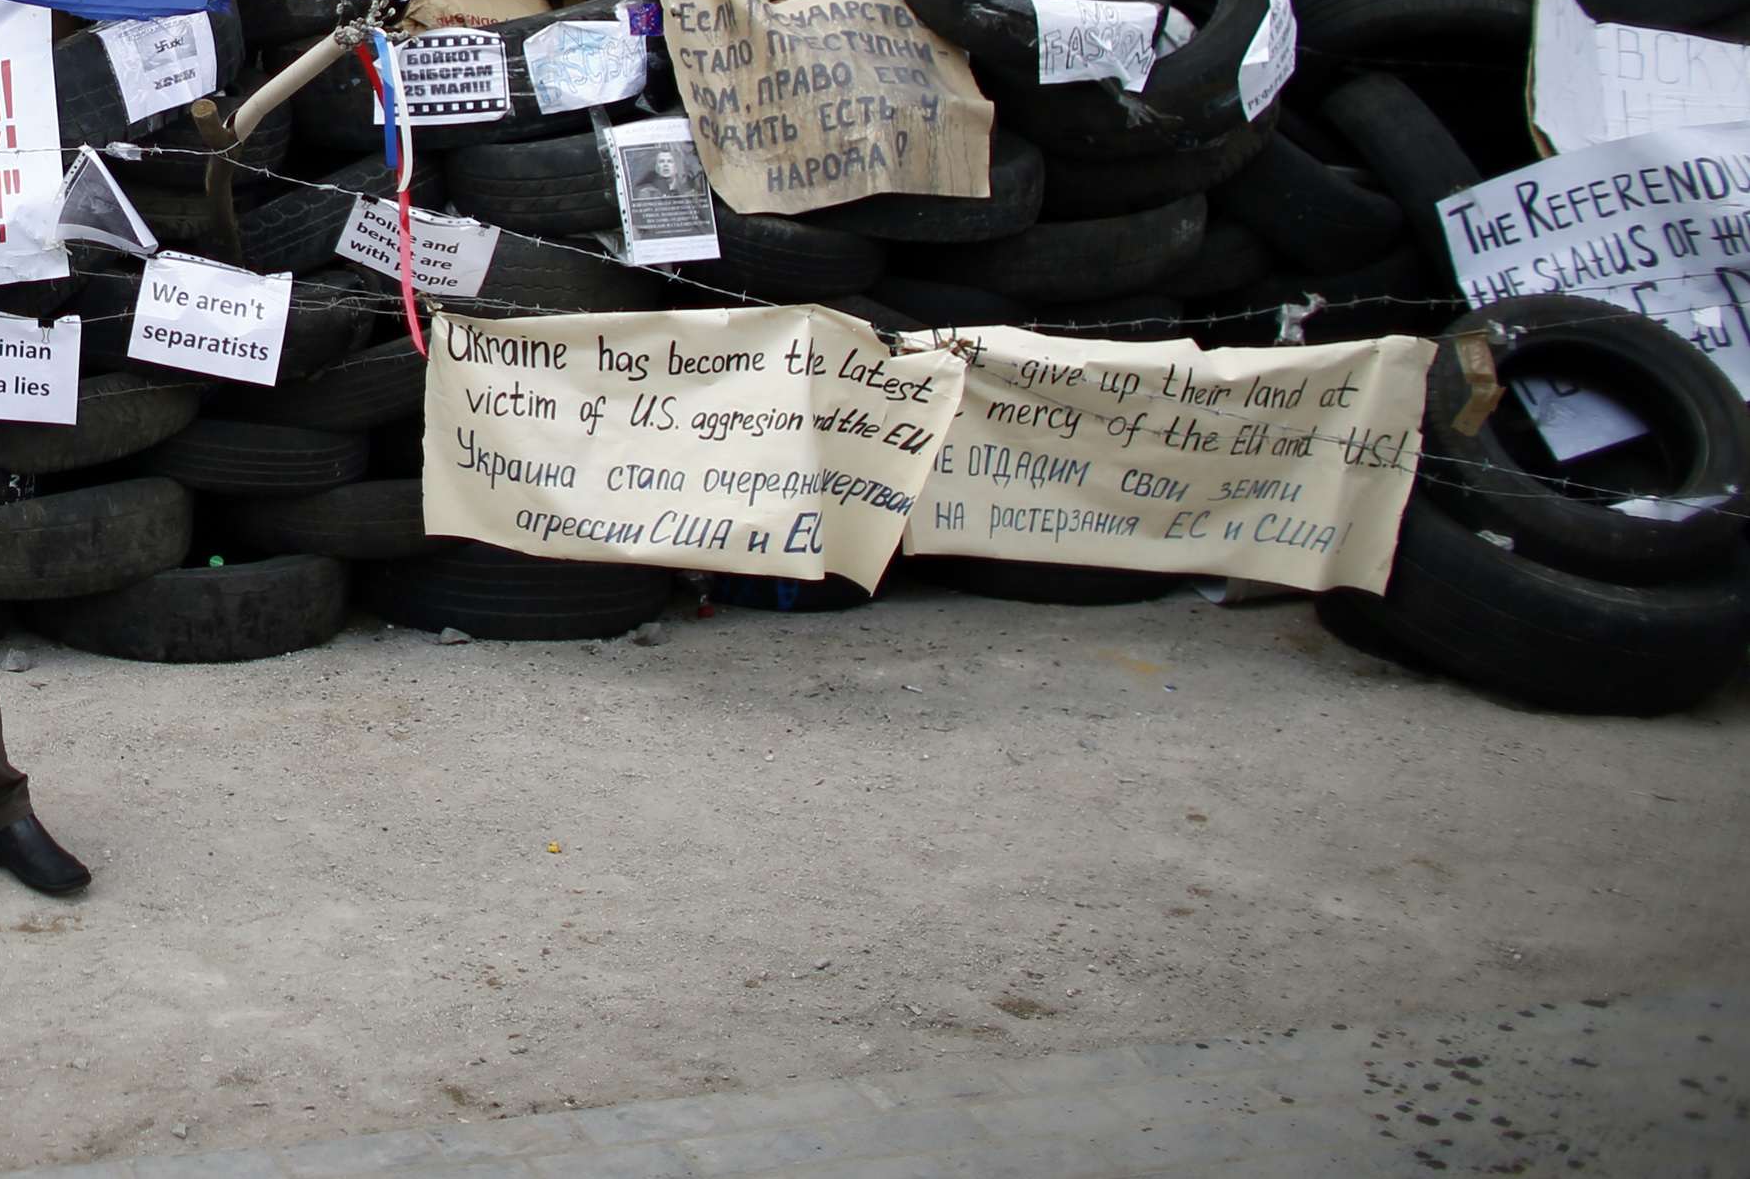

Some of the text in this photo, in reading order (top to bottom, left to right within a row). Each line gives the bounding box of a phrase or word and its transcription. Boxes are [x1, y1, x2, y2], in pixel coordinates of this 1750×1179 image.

[406, 49, 483, 66] БОЙКОТ
[680, 39, 752, 73] СТАЛО
[404, 80, 492, 96] 25 МАЯ!!!
[758, 61, 853, 106] ПРАВО
[700, 94, 939, 151] СУДИТЬ ЕСТЬ У
[350, 239, 391, 263] with
[420, 256, 453, 270] are
[422, 239, 460, 254] and
[151, 281, 265, 322] We aren't
[142, 322, 270, 362] separatists
[447, 325, 568, 370] Ukraine
[597, 335, 650, 381] has
[668, 341, 766, 375] become
[13, 373, 51, 398] lies
[1021, 358, 1360, 411] give up their land at
[466, 381, 557, 422] victim
[579, 401, 606, 435] of
[629, 394, 682, 431] U.S.
[691, 410, 804, 442] aggresion
[836, 408, 881, 439] the
[987, 403, 1083, 438] mercy
[1107, 415, 1149, 448] of
[1163, 415, 1220, 453] the
[1271, 432, 1313, 459] and
[456, 427, 578, 489] Украина
[606, 462, 687, 492] стала
[967, 444, 1091, 488] ОТДАДИМ
[516, 507, 771, 554] агрессии США и
[935, 501, 965, 531] НА
[1164, 511, 1208, 540] ЕС
[1223, 522, 1242, 541] и
